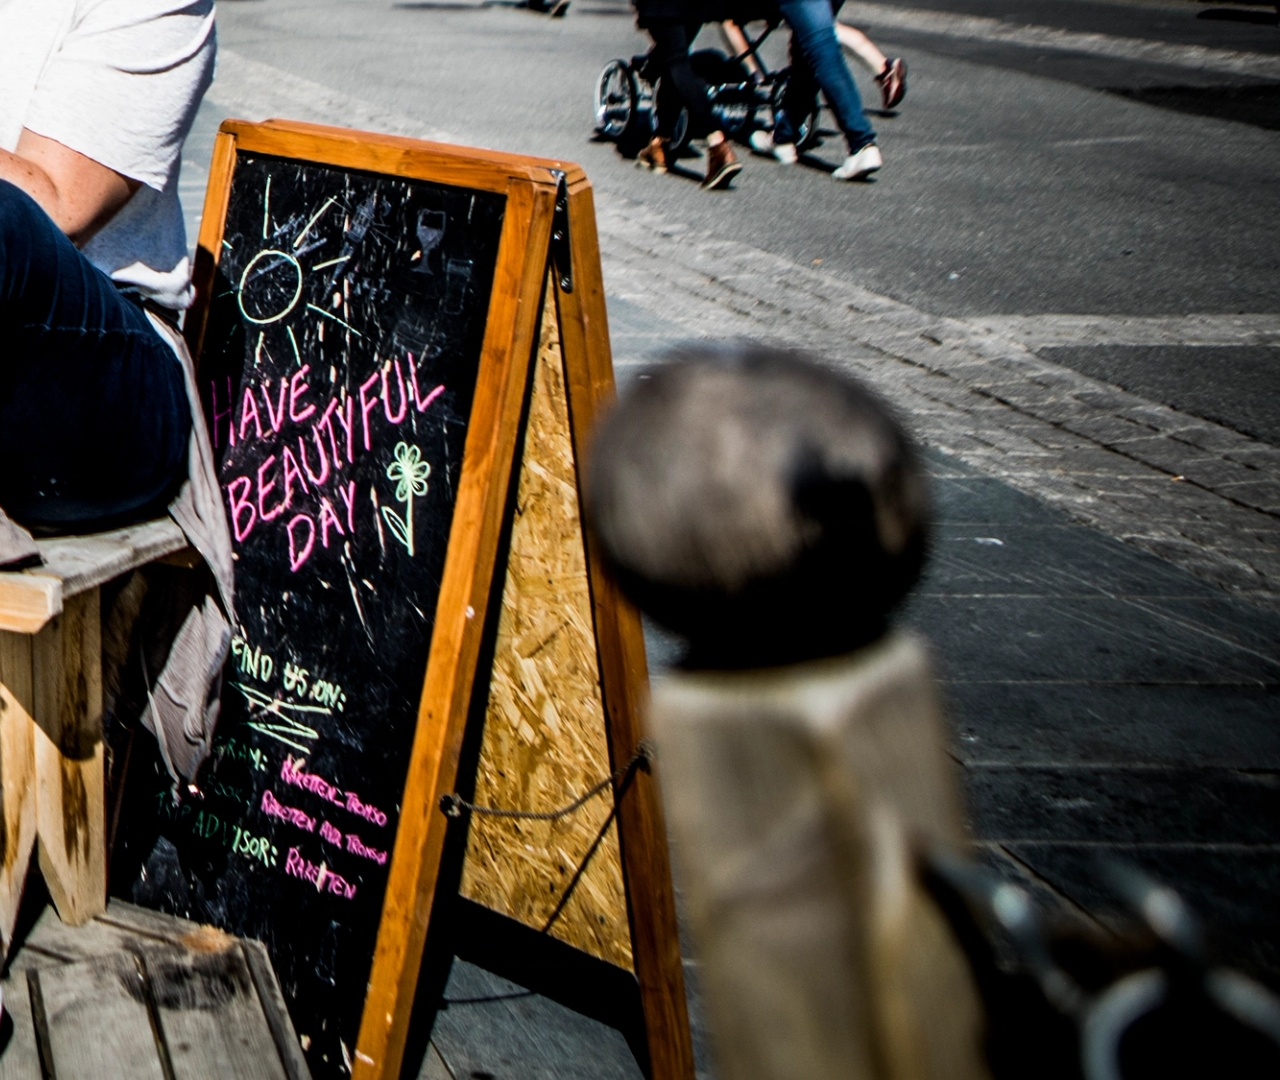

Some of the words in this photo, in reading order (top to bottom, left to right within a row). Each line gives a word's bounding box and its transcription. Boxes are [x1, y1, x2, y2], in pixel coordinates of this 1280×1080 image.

[211, 364, 317, 449] HAVE
[227, 352, 447, 543] BEAUTYFUL
[286, 480, 357, 574] DAY
[231, 636, 274, 683] FIND
[283, 661, 310, 697] US
